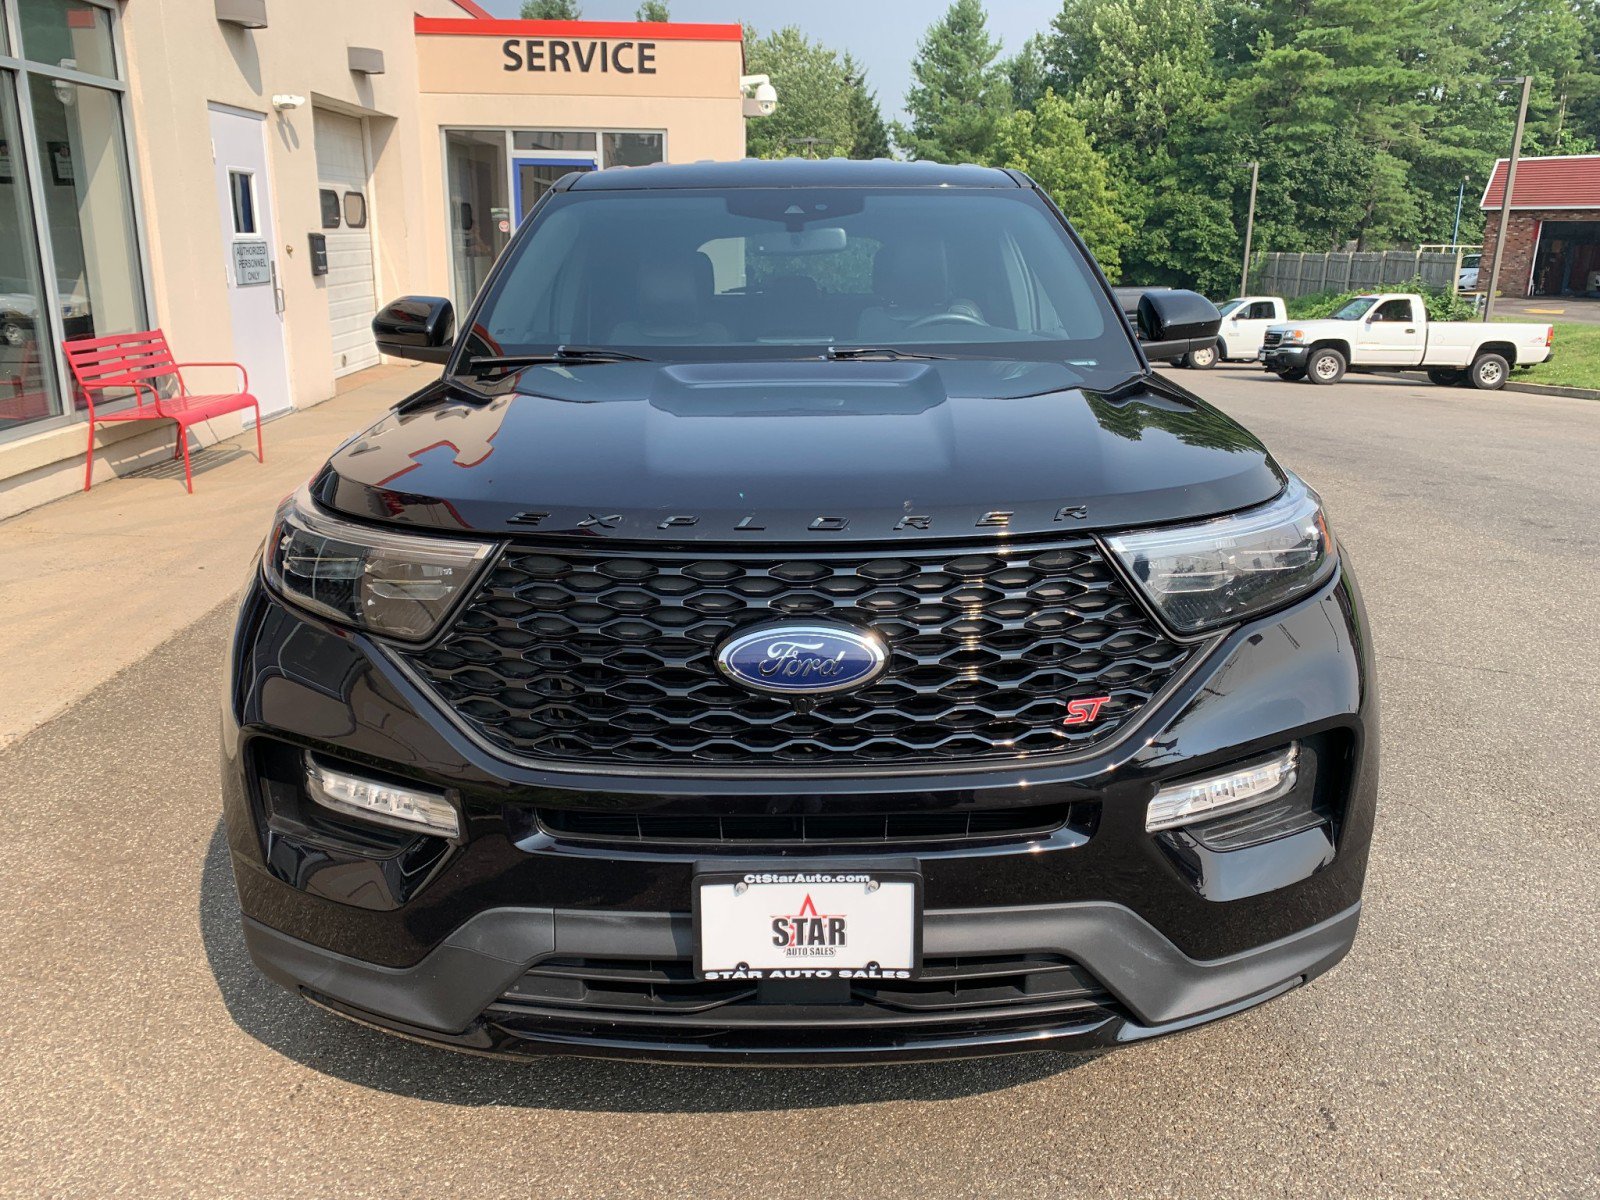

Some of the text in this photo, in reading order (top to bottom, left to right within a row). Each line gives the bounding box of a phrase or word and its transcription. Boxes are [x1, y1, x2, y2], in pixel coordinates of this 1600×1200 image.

[502, 39, 657, 74] SERVICE
[236, 246, 265, 255] AUTHORIZED
[238, 259, 267, 268] PERSONNEL
[247, 271, 259, 280] ONLY
[505, 504, 1087, 531] EXPLORER
[758, 641, 847, 677] Ford
[1063, 695, 1111, 725] ST
[743, 874, 870, 883] CtStarAuto.com
[771, 917, 846, 947] STAR
[786, 947, 835, 956] AUTO SALES
[704, 969, 911, 980] STAR AUTO SALES
